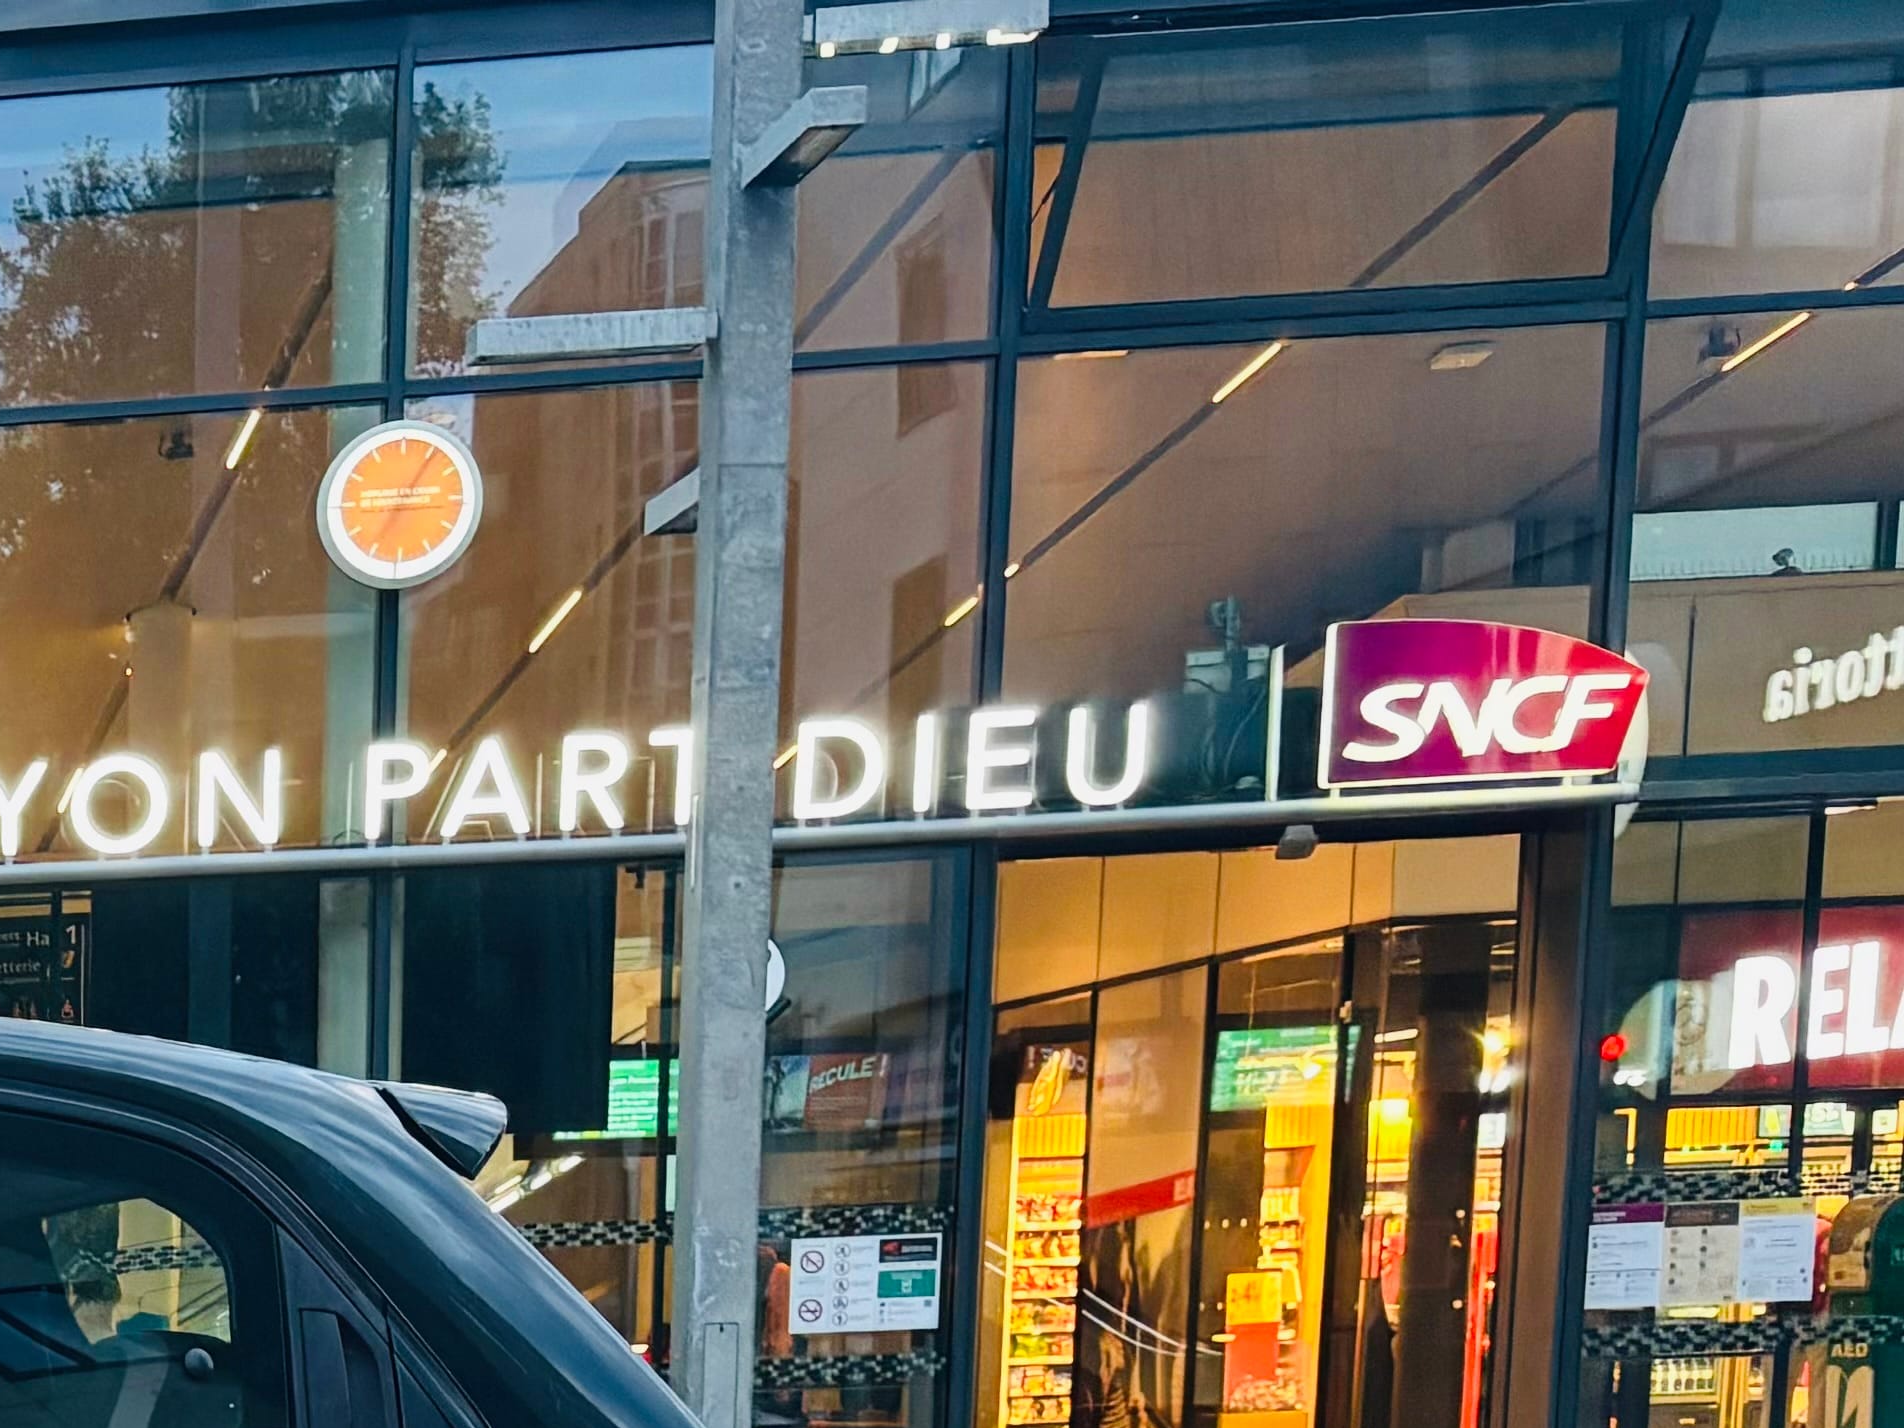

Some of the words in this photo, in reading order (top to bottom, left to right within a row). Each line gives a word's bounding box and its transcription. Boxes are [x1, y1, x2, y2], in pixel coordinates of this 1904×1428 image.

[1342, 672, 1633, 763] SNCF
[364, 728, 693, 841] PART
[794, 700, 1149, 820] DIEU
[1729, 940, 1904, 1070] REL
[808, 1055, 877, 1094] RECULE
[1830, 1342, 1869, 1359] AED
